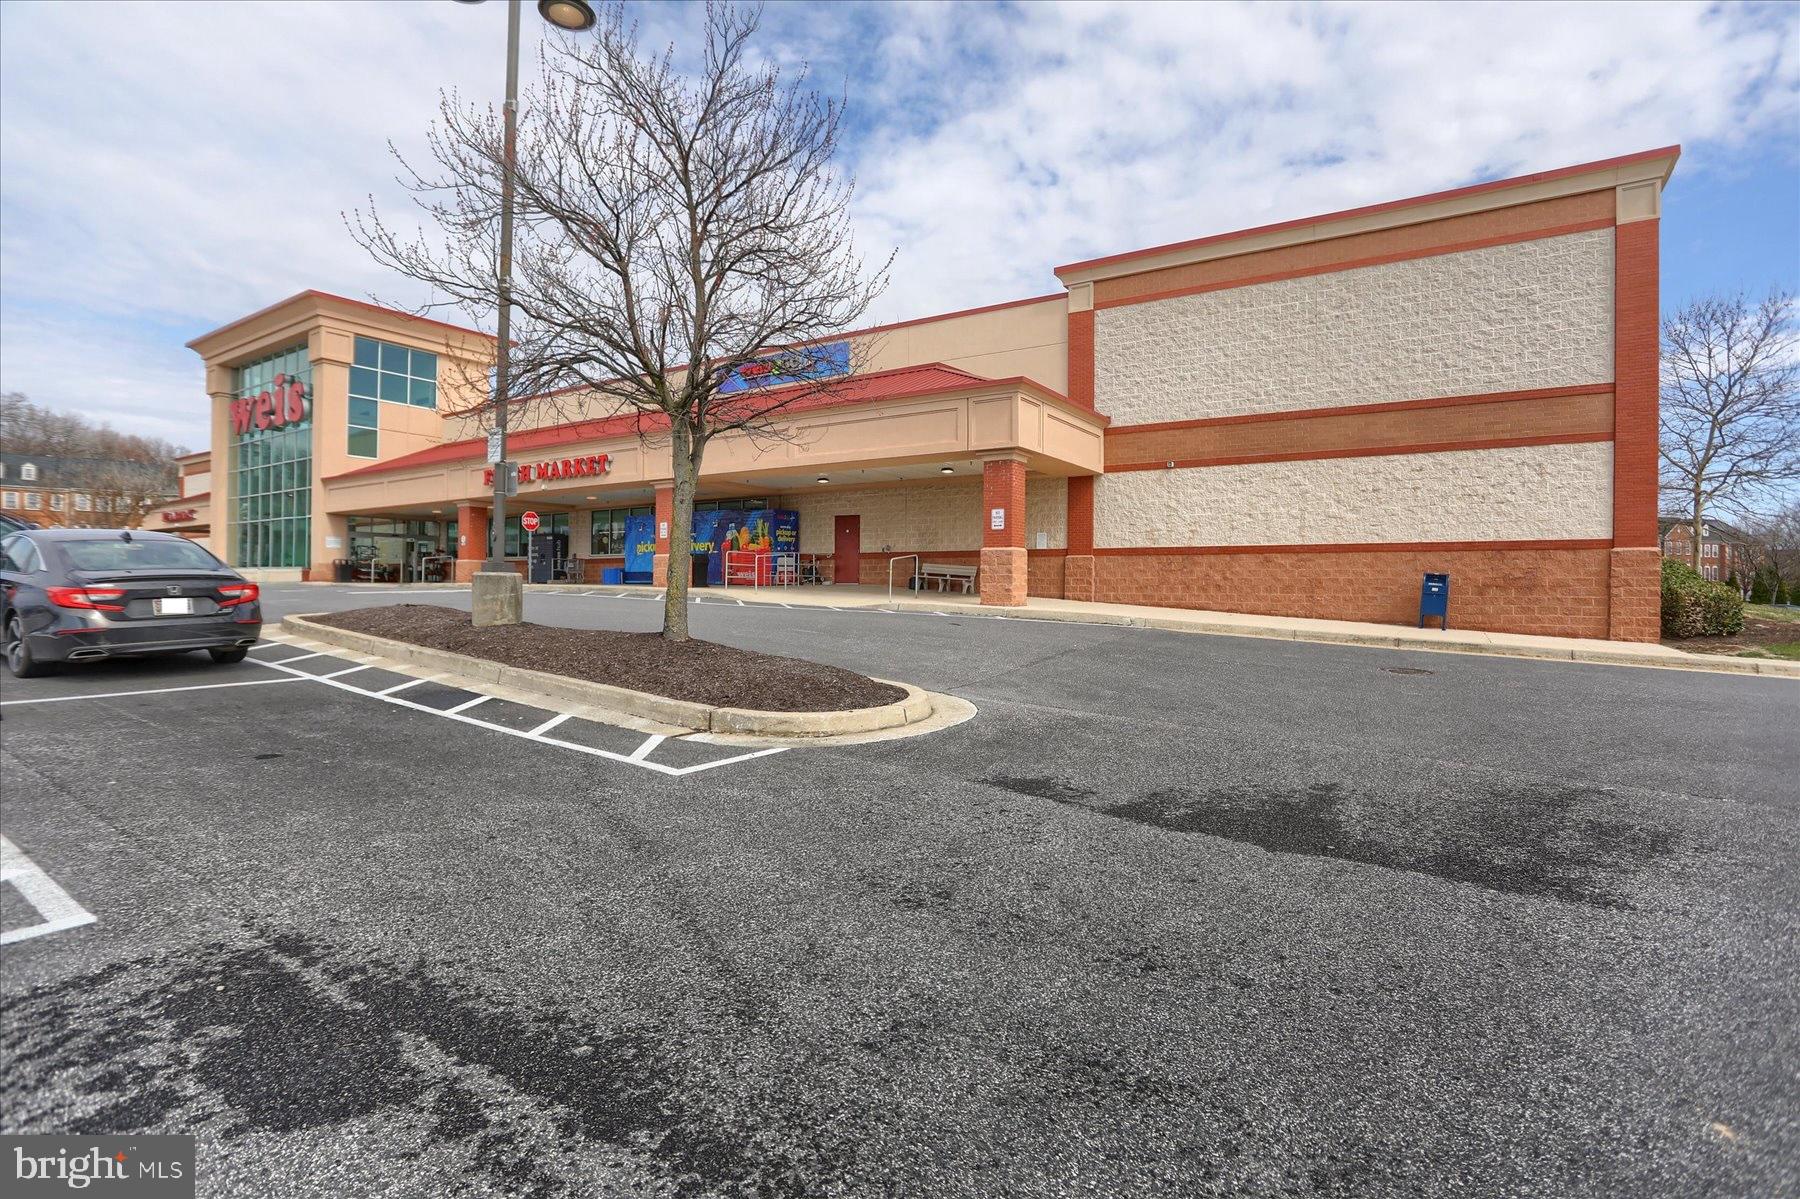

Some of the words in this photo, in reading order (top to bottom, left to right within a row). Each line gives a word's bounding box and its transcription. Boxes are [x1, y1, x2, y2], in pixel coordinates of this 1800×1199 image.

[229, 373, 305, 436] weis
[535, 453, 609, 480] MARKET
[523, 517, 538, 525] STOP
